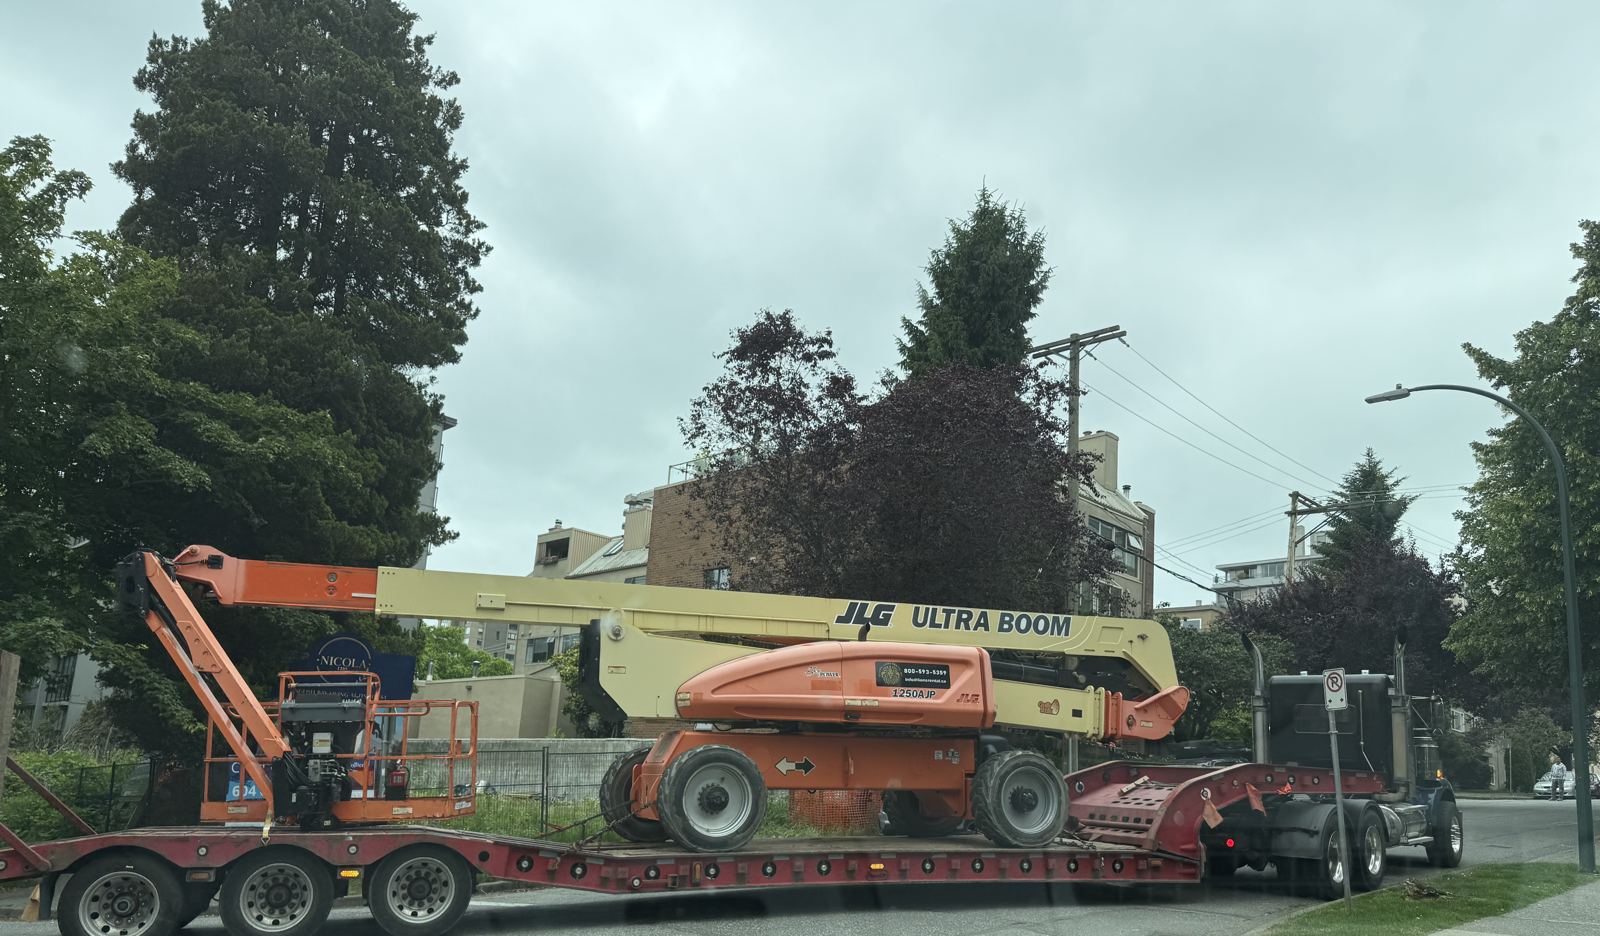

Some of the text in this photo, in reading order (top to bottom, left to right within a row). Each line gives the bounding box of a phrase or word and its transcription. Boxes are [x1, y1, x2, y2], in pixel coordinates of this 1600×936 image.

[835, 601, 896, 627] JLG
[911, 605, 1072, 637] ULTRA BOOM
[320, 655, 366, 669] NICOLA
[892, 689, 936, 699] 1250AJP
[956, 693, 980, 704] JLG
